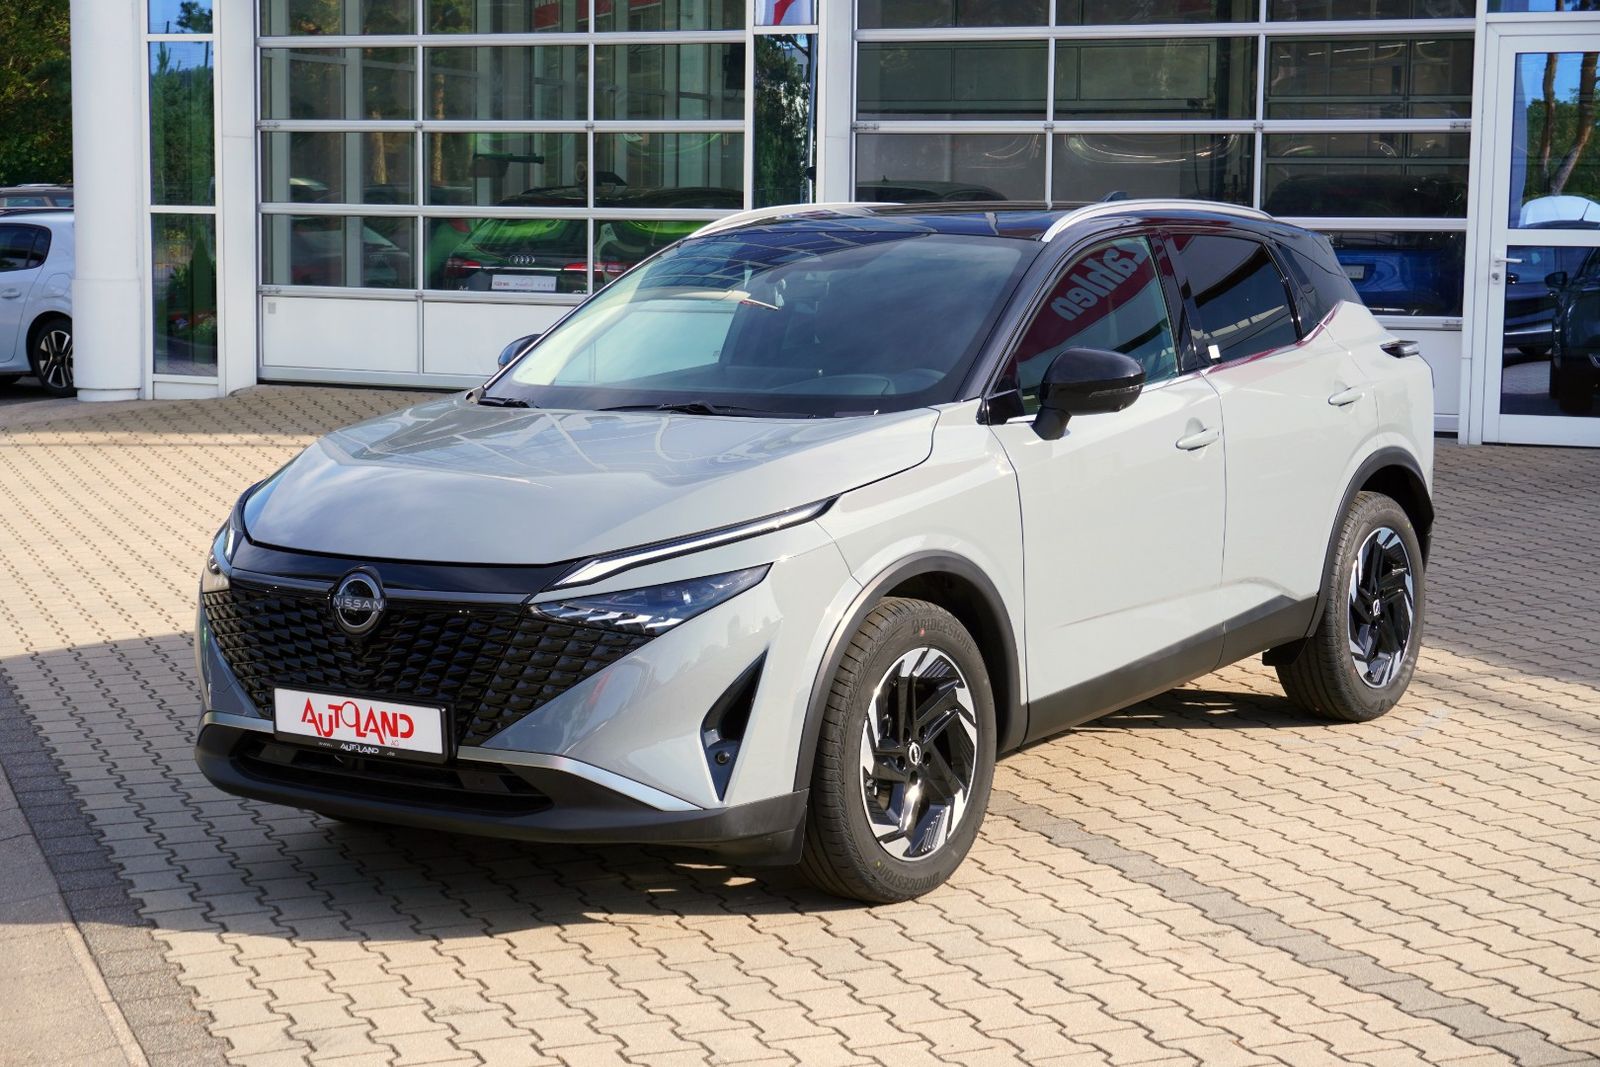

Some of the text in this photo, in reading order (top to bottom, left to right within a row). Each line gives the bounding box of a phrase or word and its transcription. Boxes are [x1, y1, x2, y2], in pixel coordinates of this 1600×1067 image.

[333, 596, 384, 611] NISSAN
[301, 697, 415, 746] AUTOLAND
[340, 742, 380, 755] AUTOLAND
[873, 859, 941, 891] BRIDGESTON
